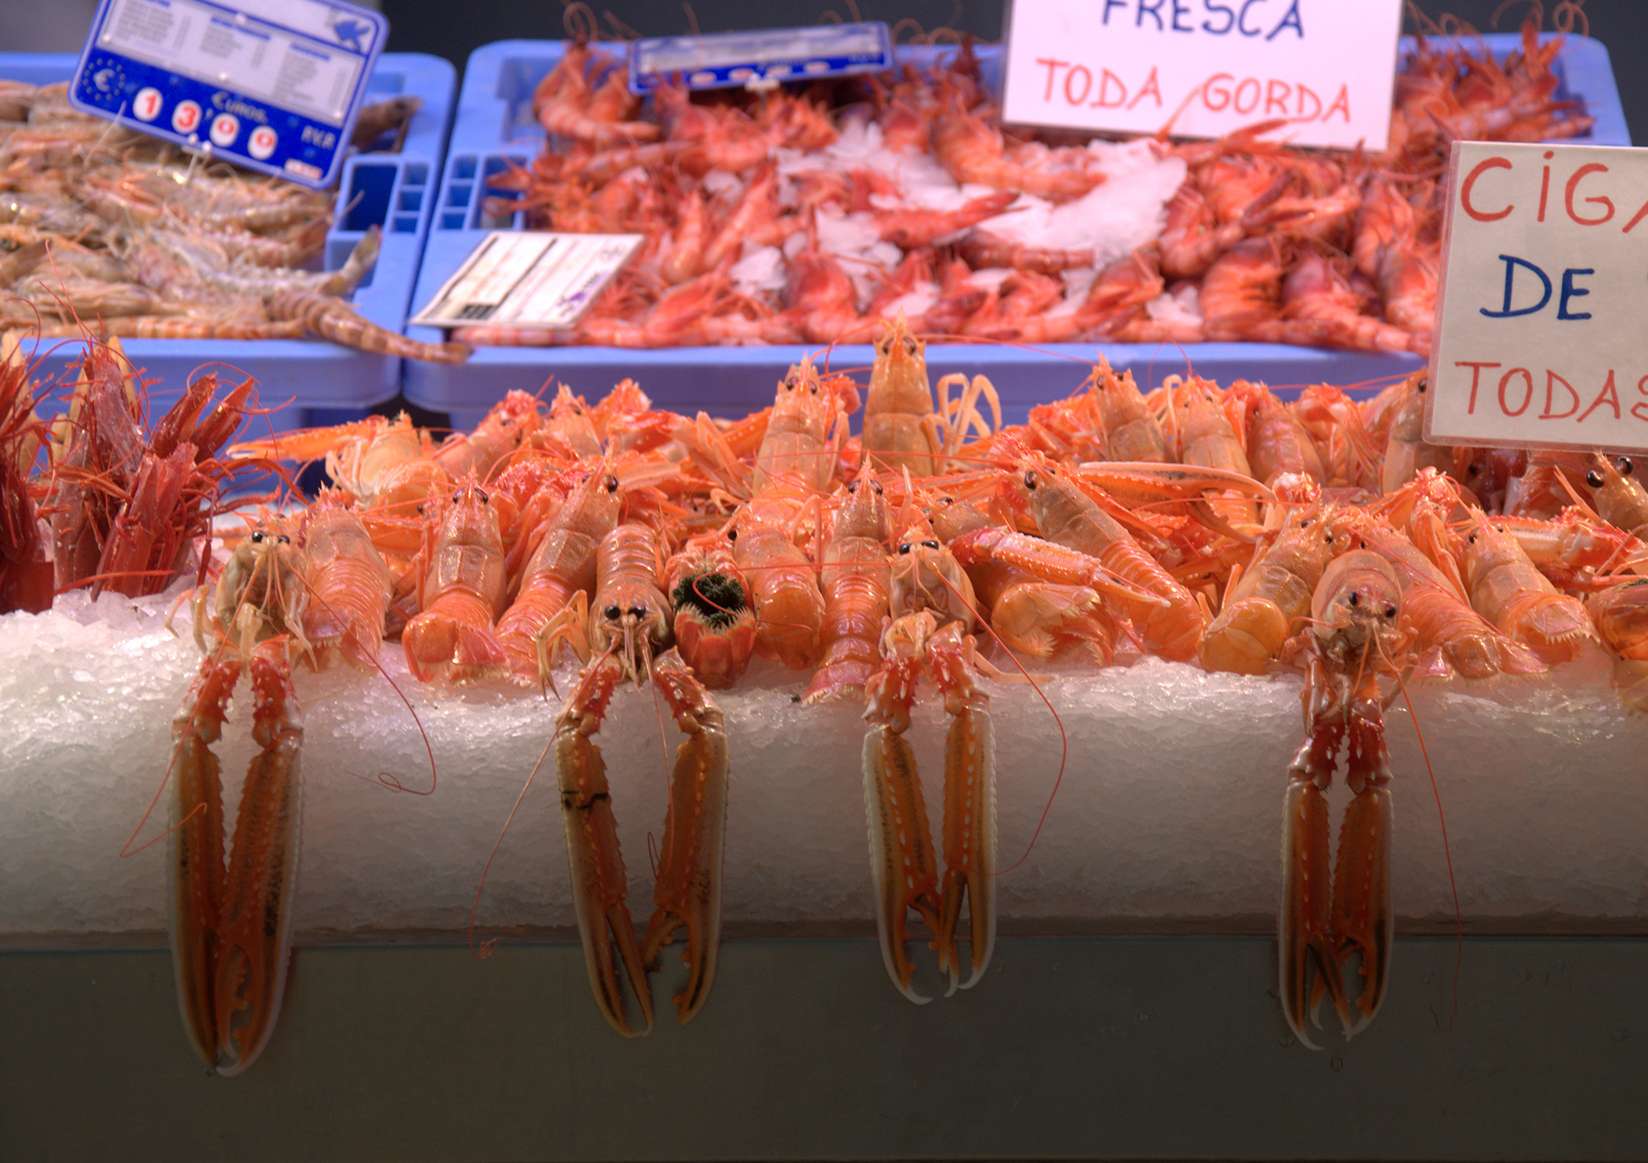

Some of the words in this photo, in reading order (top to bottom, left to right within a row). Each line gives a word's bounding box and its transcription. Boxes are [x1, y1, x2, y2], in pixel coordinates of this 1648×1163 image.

[1036, 58, 1162, 110] TODA
[1203, 72, 1350, 123] GORDA
[1479, 254, 1595, 320] DE
